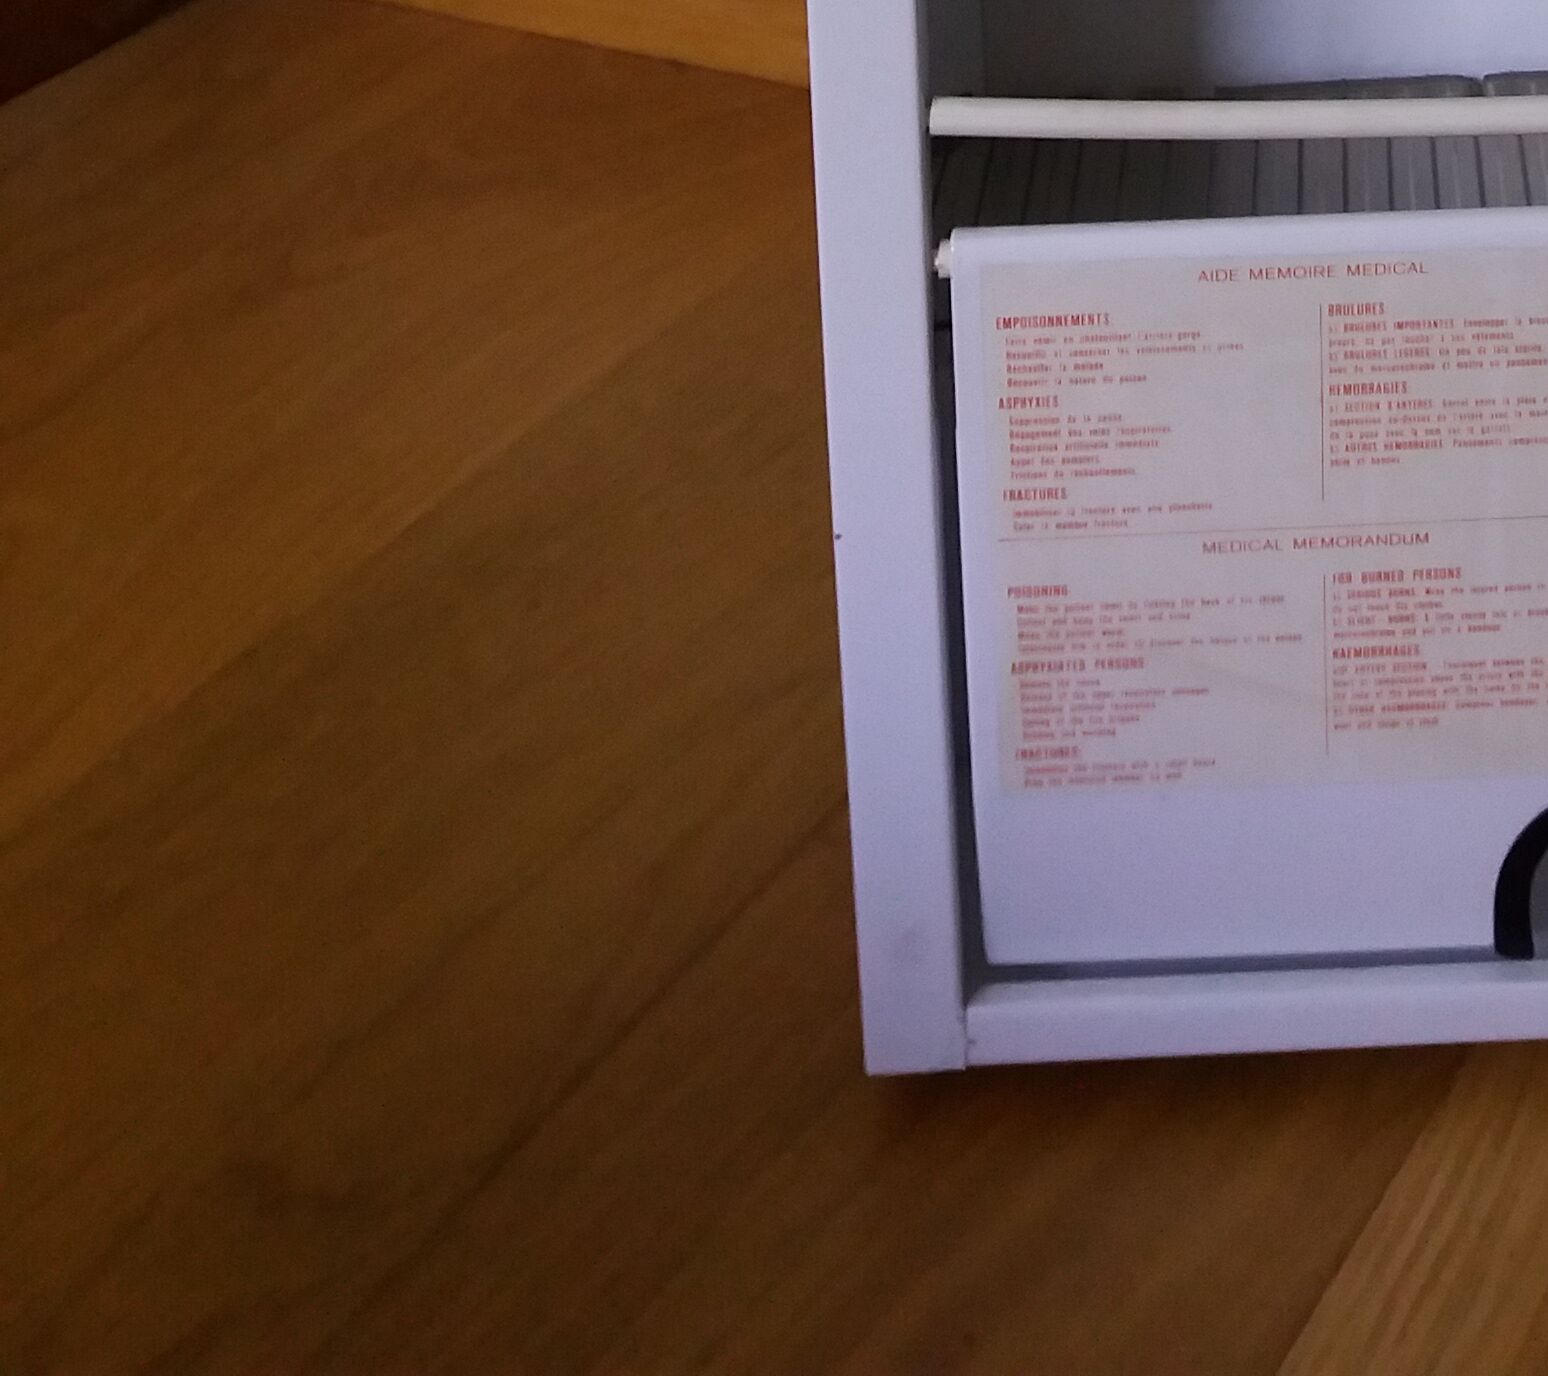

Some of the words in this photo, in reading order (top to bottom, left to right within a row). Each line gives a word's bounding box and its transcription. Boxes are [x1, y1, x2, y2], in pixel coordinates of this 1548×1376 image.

[1198, 268, 1240, 282] AIDE
[1249, 265, 1336, 280] MEMOIRE
[1347, 262, 1429, 276] MEDICAL
[1328, 302, 1384, 317] BRULURES
[1003, 488, 1068, 501] FRACTURES
[1202, 539, 1282, 554] MEDICAL
[1293, 532, 1429, 550] MEMORANDUM
[1413, 567, 1462, 581] PERSONS
